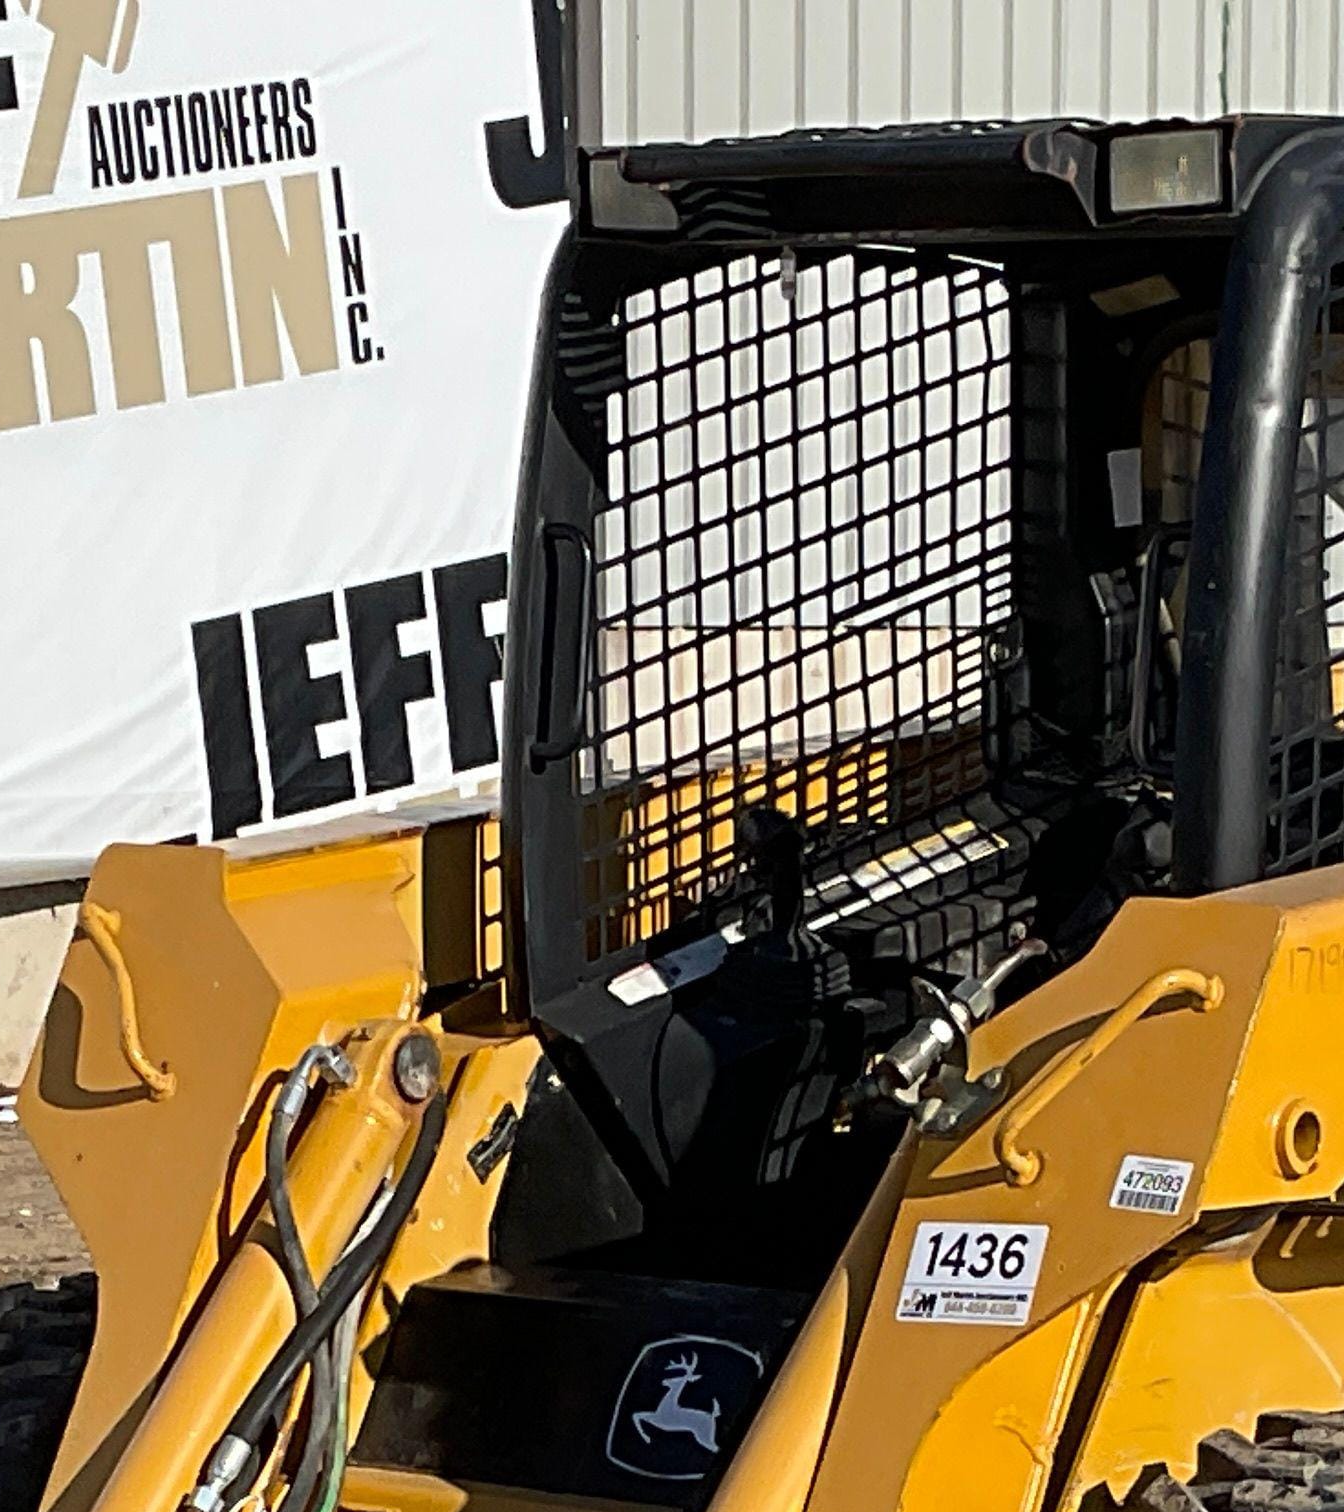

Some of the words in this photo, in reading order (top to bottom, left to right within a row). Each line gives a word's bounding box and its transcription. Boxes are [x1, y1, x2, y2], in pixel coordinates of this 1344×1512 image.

[89, 78, 317, 189] AUCTIONEERS
[156, 551, 509, 843] JEFF
[925, 1231, 1029, 1280] 1436
